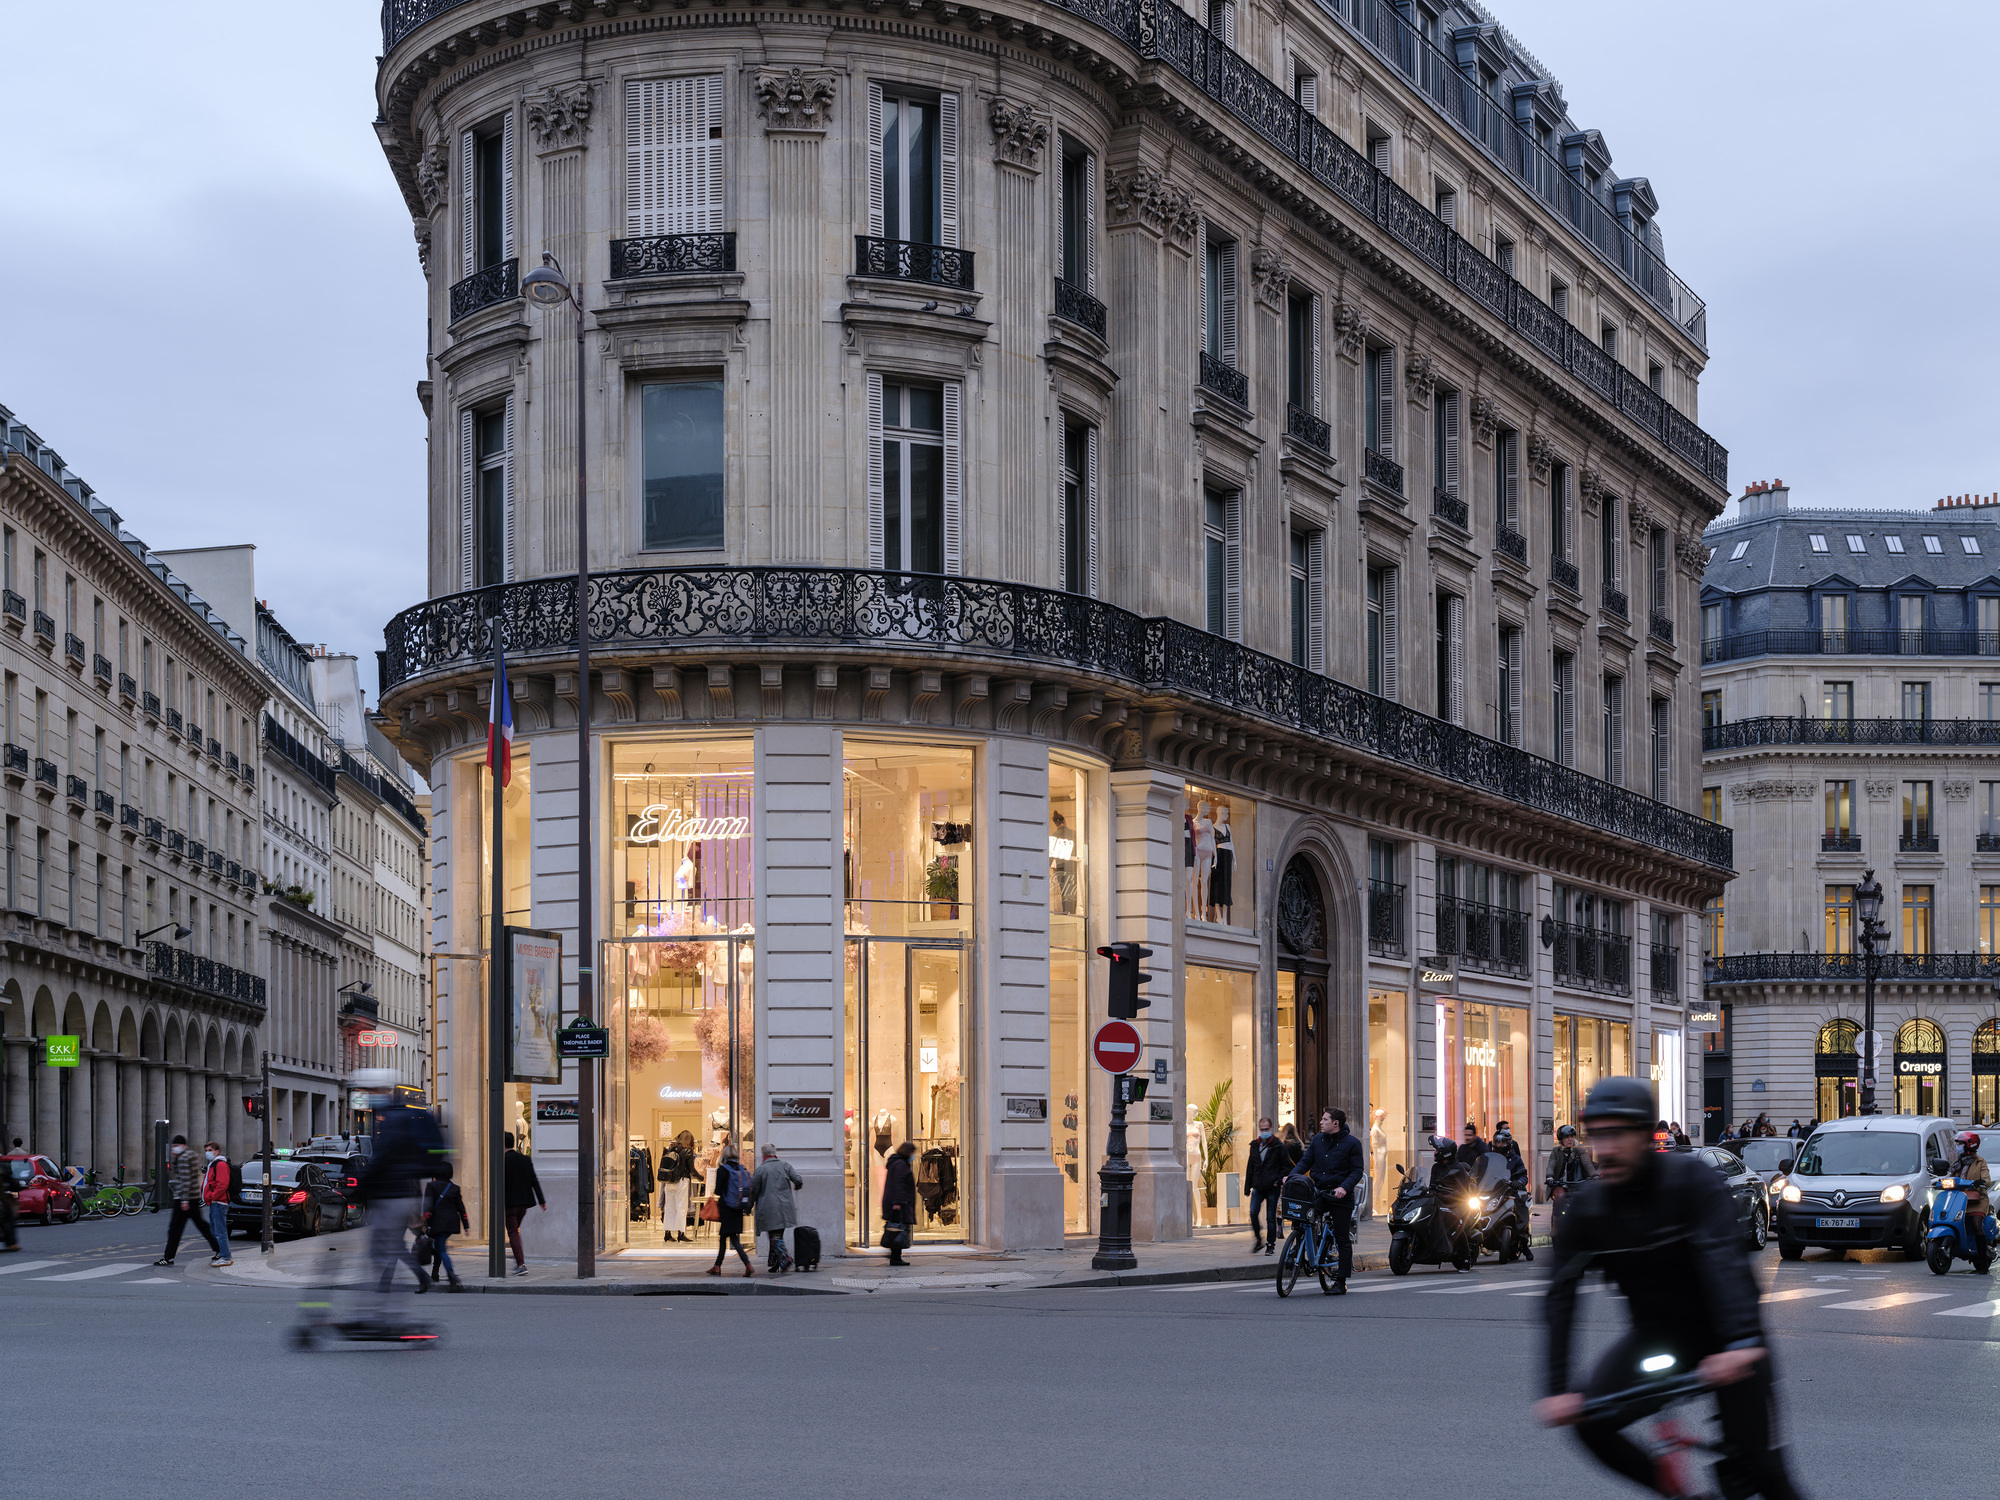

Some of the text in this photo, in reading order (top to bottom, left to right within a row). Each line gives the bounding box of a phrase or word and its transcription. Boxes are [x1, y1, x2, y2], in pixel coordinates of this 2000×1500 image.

[630, 804, 749, 843] Etam
[1422, 971, 1453, 982] Etam
[1691, 1013, 1717, 1021] undiz
[1465, 1042, 1496, 1067] undiz
[1900, 1061, 1942, 1074] Orange
[544, 1103, 576, 1117] Etam
[781, 1099, 821, 1114] Etam
[1820, 1219, 1855, 1227] EK-767-JX
